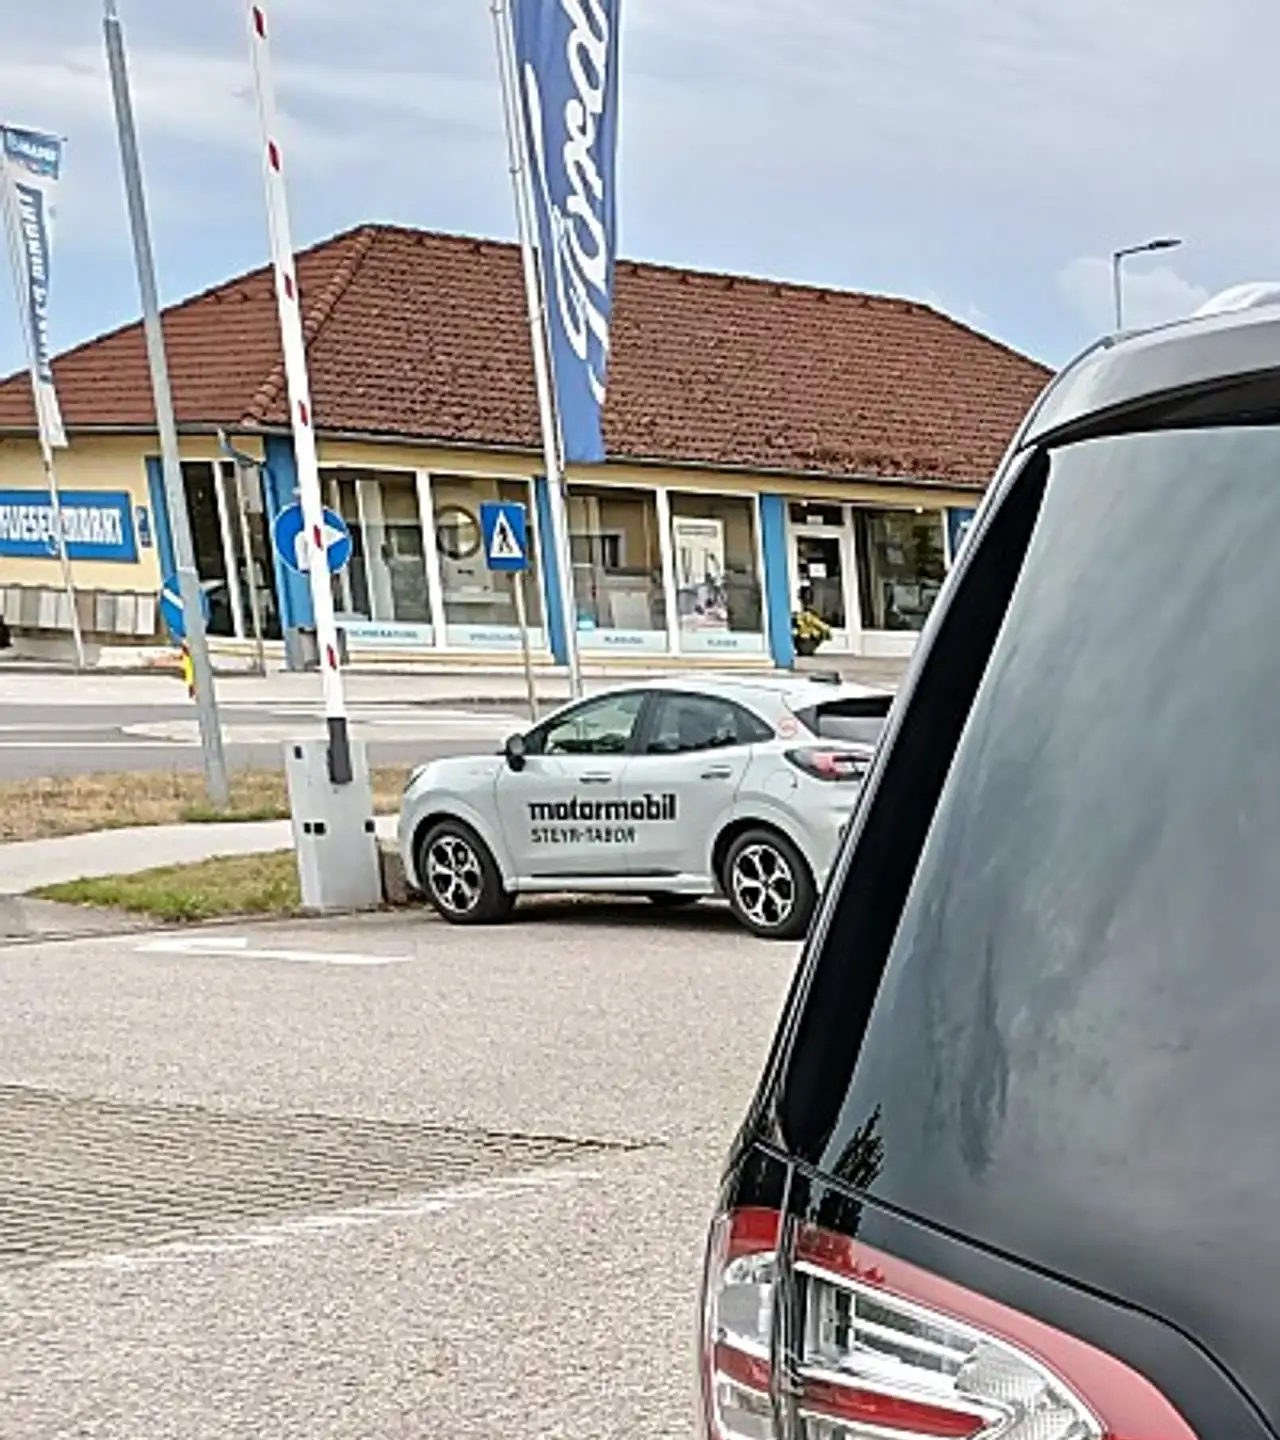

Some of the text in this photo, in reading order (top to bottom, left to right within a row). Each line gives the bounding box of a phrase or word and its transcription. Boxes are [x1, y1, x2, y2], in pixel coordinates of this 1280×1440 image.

[524, 0, 610, 404] Ford
[528, 793, 677, 821] motormobil
[531, 827, 636, 843] STEYR-TABOR
